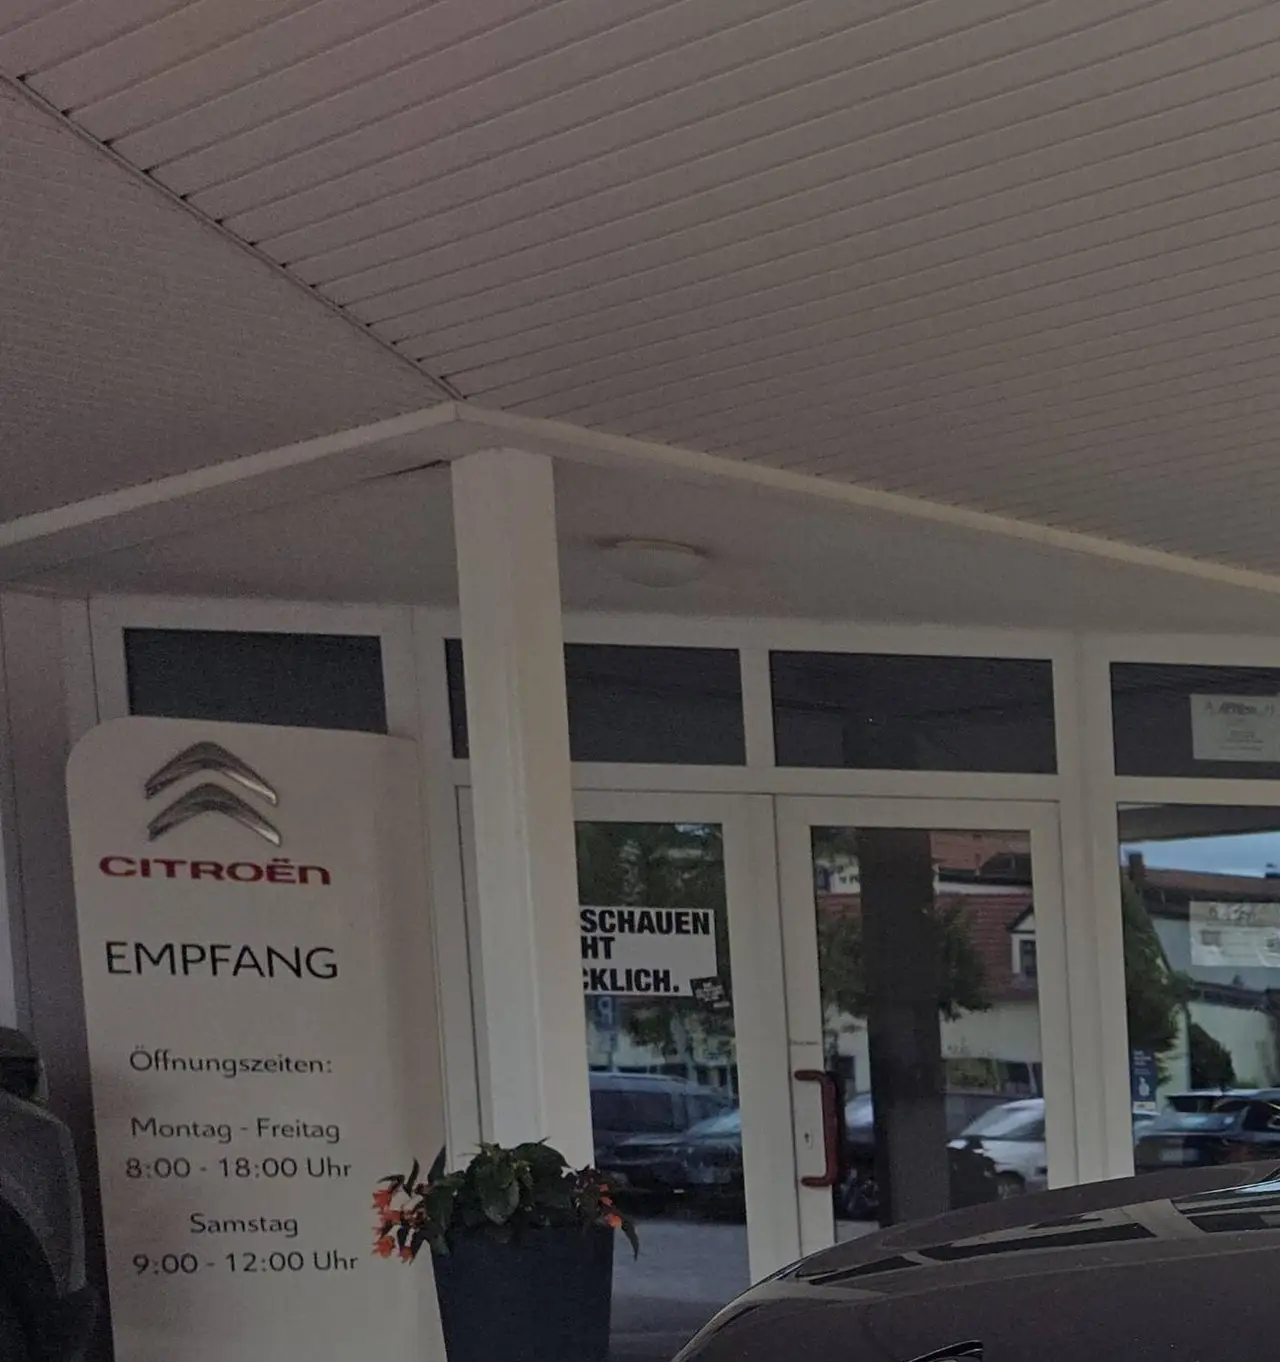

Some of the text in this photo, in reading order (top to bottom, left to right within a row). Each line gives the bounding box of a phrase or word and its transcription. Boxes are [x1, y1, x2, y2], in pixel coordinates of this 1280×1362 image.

[580, 909, 710, 935] SCHAUEN
[105, 941, 338, 979] EMPFANG
[129, 1044, 333, 1078] Öffnungszeiten:
[131, 1117, 232, 1144] Montag
[257, 1117, 340, 1144] Freitag
[125, 1157, 191, 1179] 8:00
[218, 1157, 298, 1178] 18:00
[306, 1157, 352, 1178] Uhr
[190, 1213, 299, 1238] Samstag
[132, 1253, 198, 1275] 9:00
[226, 1252, 304, 1273] 12:00
[313, 1250, 359, 1272] Uhr
